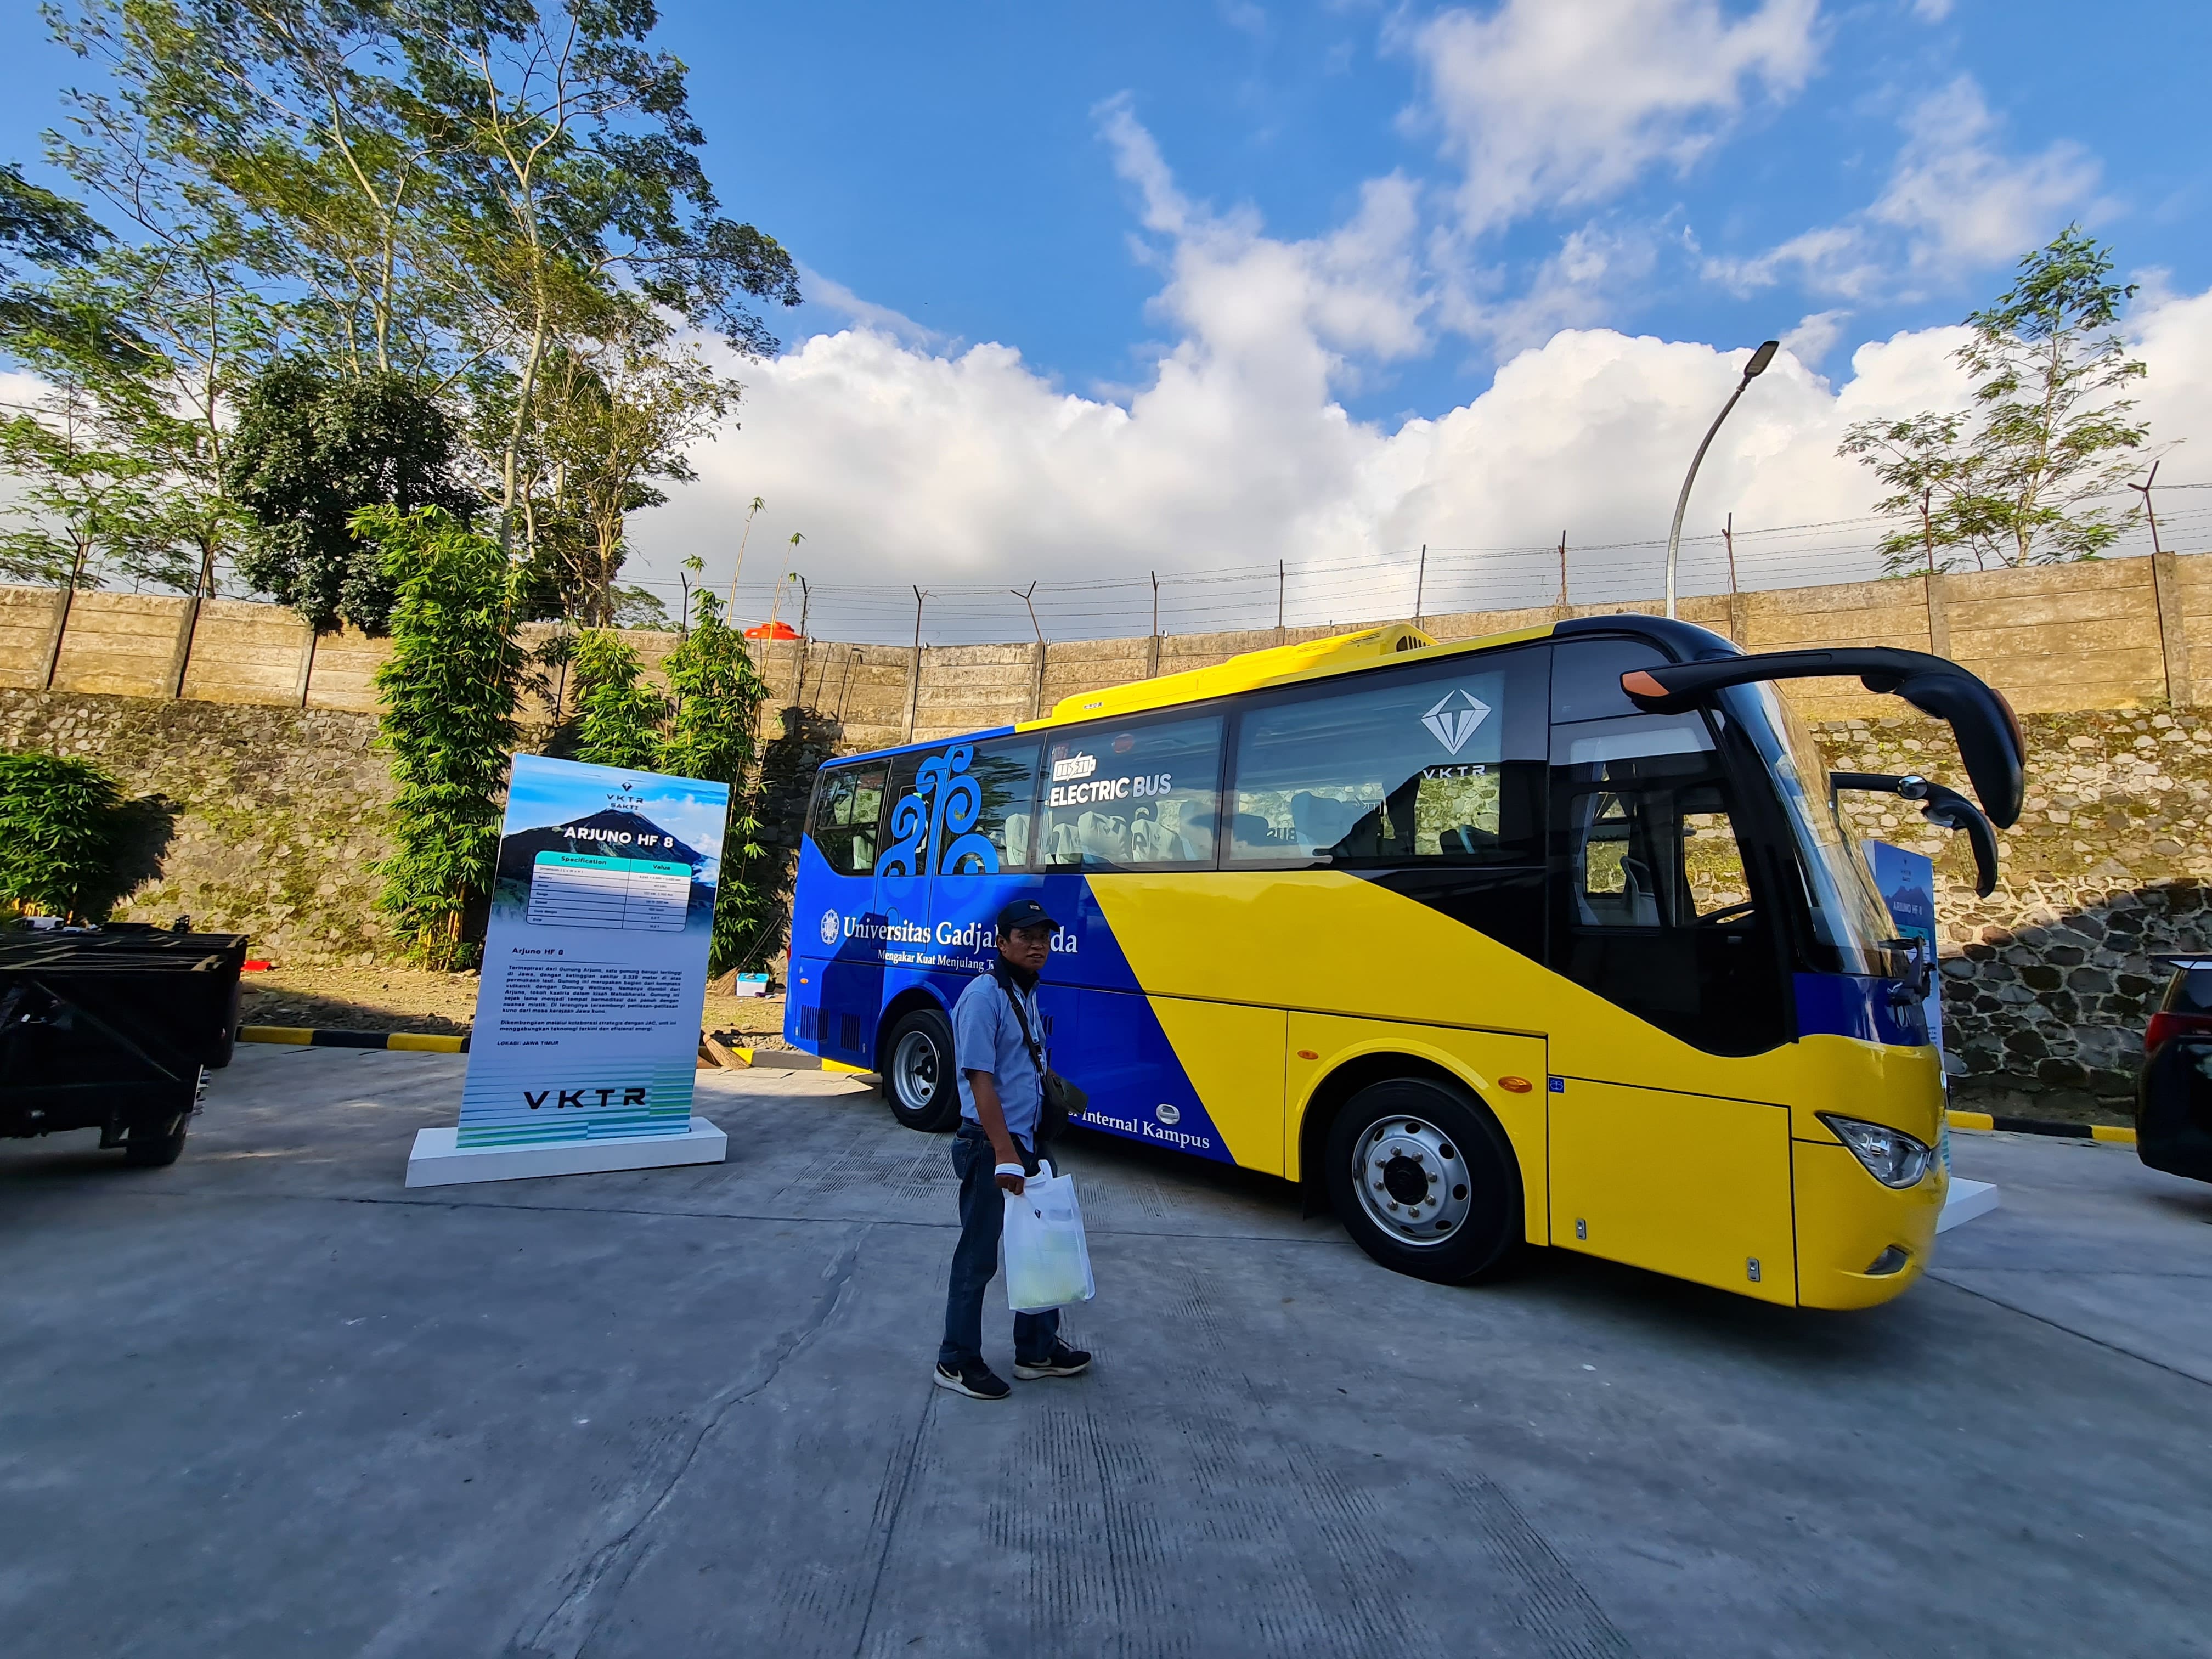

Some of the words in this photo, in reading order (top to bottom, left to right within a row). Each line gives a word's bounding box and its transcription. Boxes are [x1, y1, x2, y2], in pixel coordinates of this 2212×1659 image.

[1423, 765, 1486, 780] VKTR
[607, 794, 644, 804] VKTR
[1049, 777, 1130, 808] ELECTRIC
[1132, 774, 1172, 798] BUS
[563, 826, 631, 844] ARJUNO
[637, 834, 658, 846] HF
[663, 837, 674, 848] 8
[561, 856, 607, 865] Specification
[844, 917, 931, 943] Universitas
[878, 949, 915, 964] Mengakar
[916, 952, 936, 965] Kuat
[937, 955, 984, 973] Menjulang
[523, 1088, 646, 1110] VKTR
[1081, 1107, 1138, 1133] Internal
[1143, 1121, 1210, 1149] Kampus
